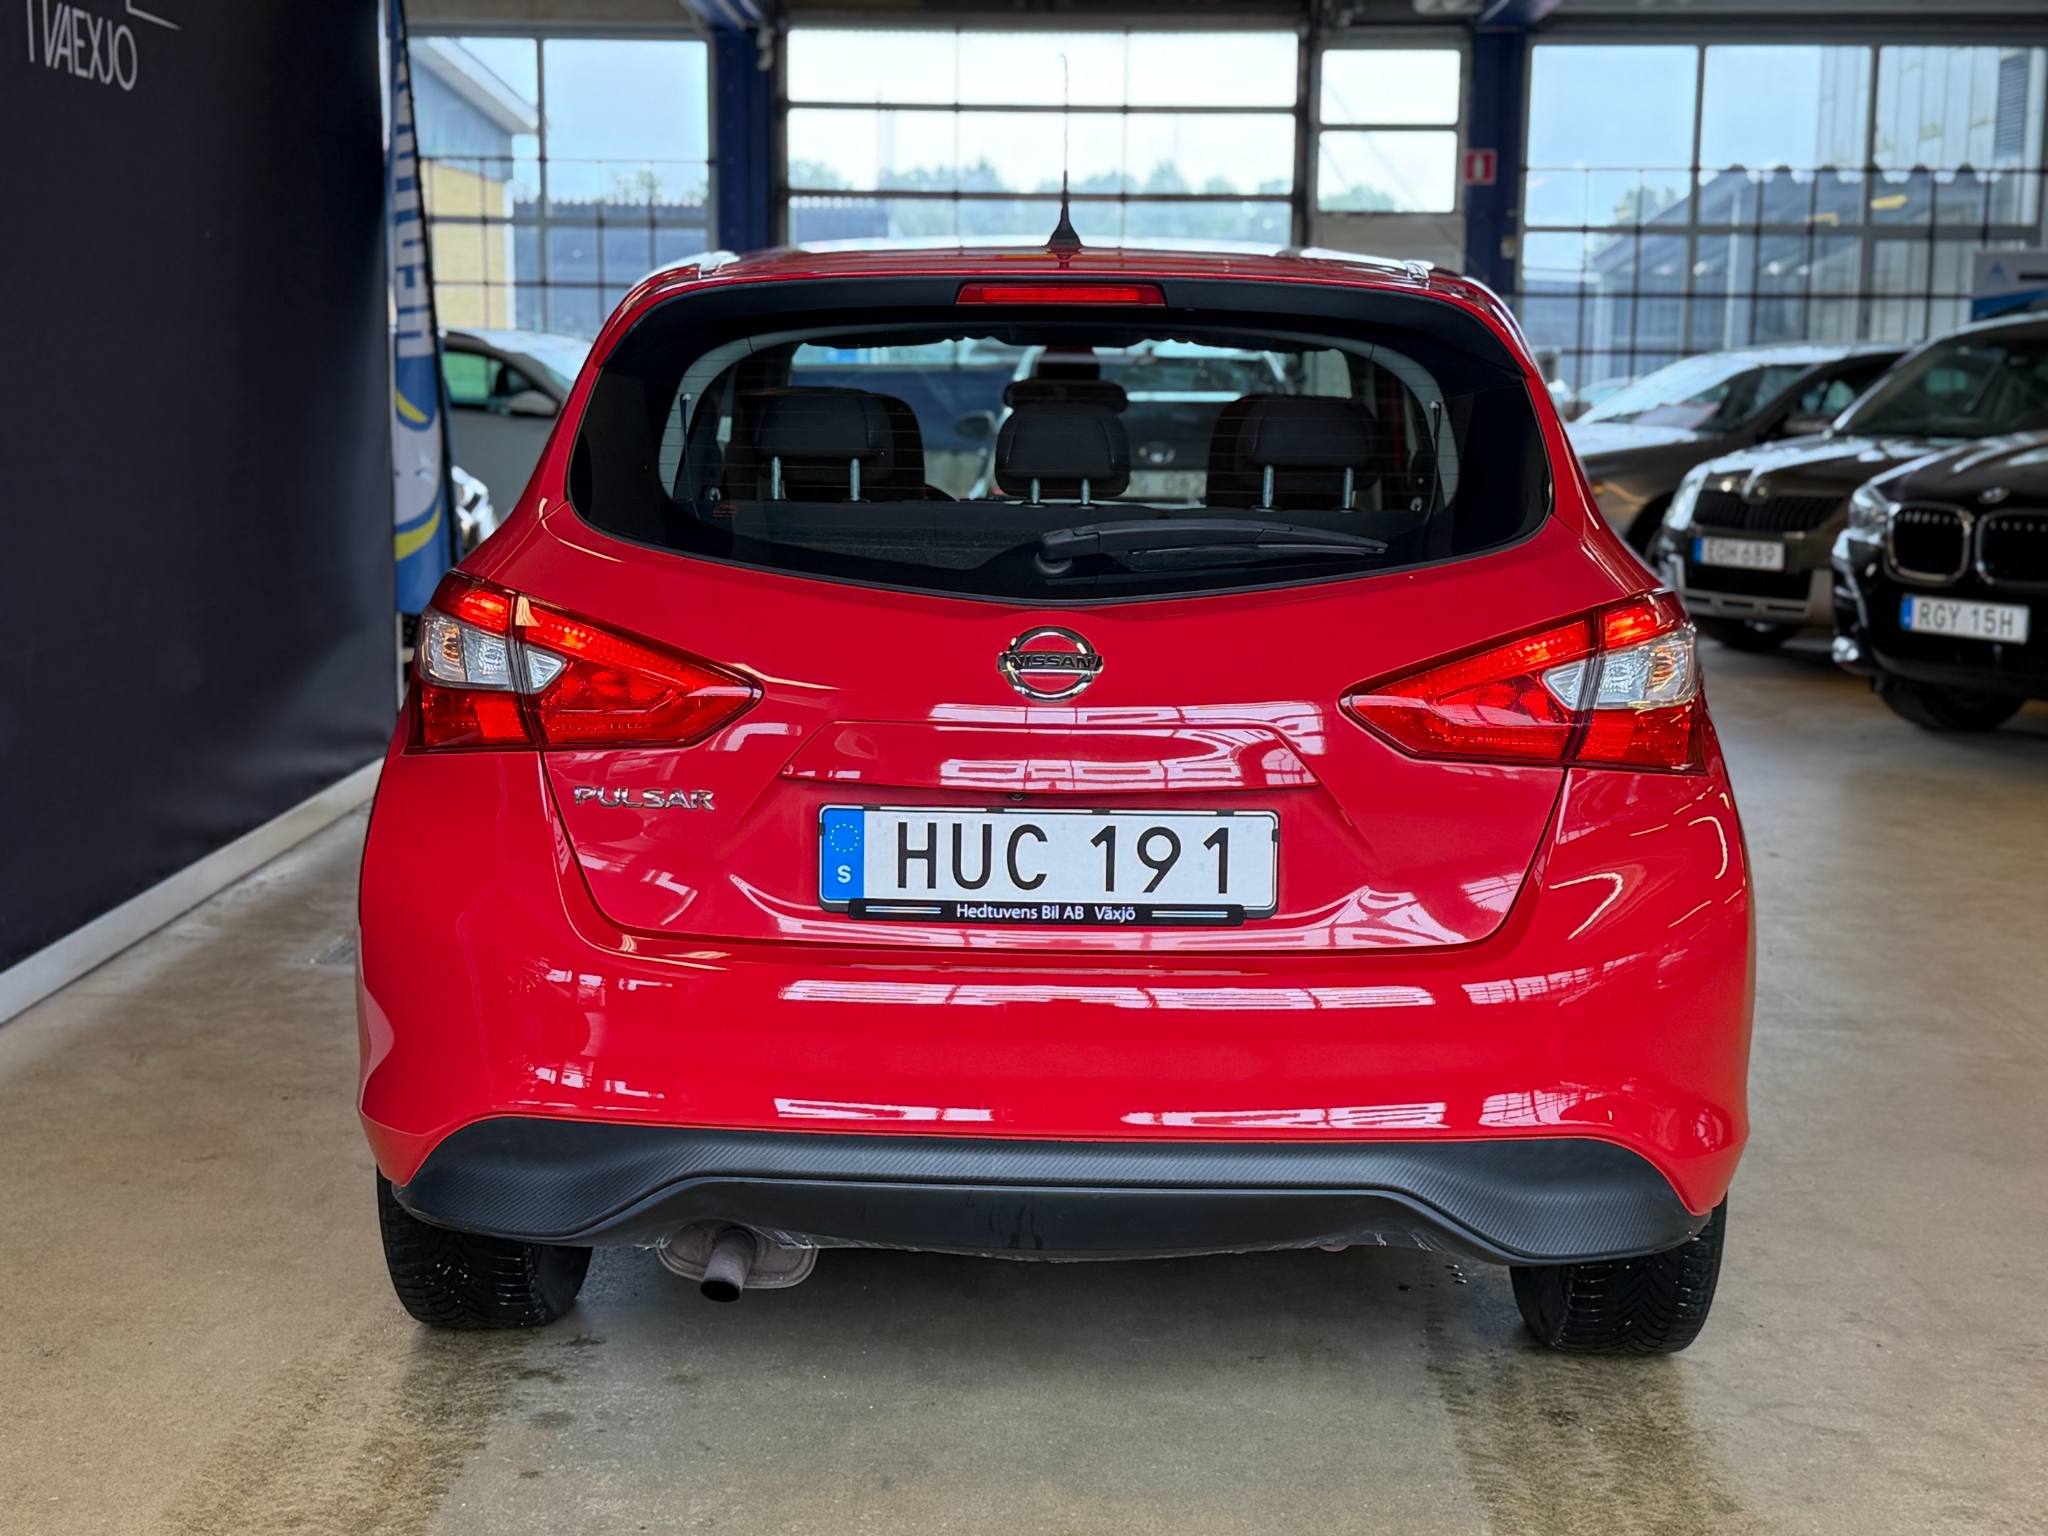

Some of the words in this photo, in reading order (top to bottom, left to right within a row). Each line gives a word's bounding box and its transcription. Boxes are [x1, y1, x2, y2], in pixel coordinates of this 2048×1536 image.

[42, 0, 138, 91] VAEXJO
[1918, 602, 1961, 630] RGY
[1971, 607, 2014, 637] 15H
[1007, 653, 1096, 669] NISSAN
[574, 786, 716, 811] PULSAR
[897, 821, 1049, 891] HUC
[1090, 824, 1229, 895] 191
[836, 864, 852, 884] S
[956, 903, 1038, 920] Hedtuvens
[1041, 905, 1060, 920] Bil
[1063, 906, 1085, 921] AB
[1094, 906, 1137, 924] Växjö
